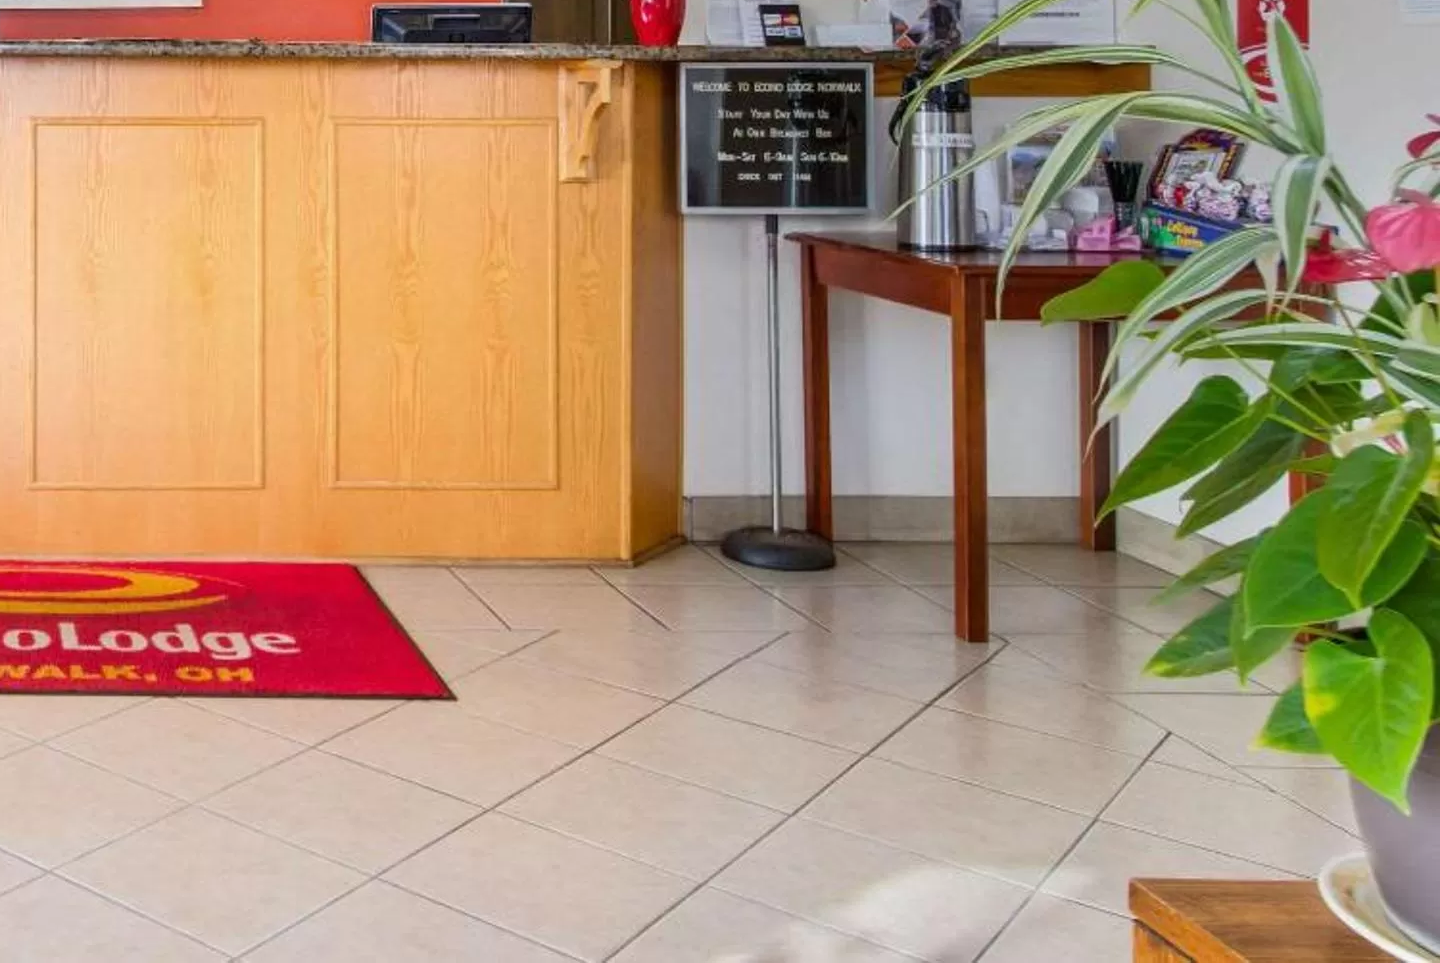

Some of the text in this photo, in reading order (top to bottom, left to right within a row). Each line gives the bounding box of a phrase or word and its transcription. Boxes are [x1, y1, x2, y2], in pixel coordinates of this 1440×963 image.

[692, 81, 862, 93] WELCOME TO ECONO LODGE NORWALK
[175, 665, 255, 683] OH
